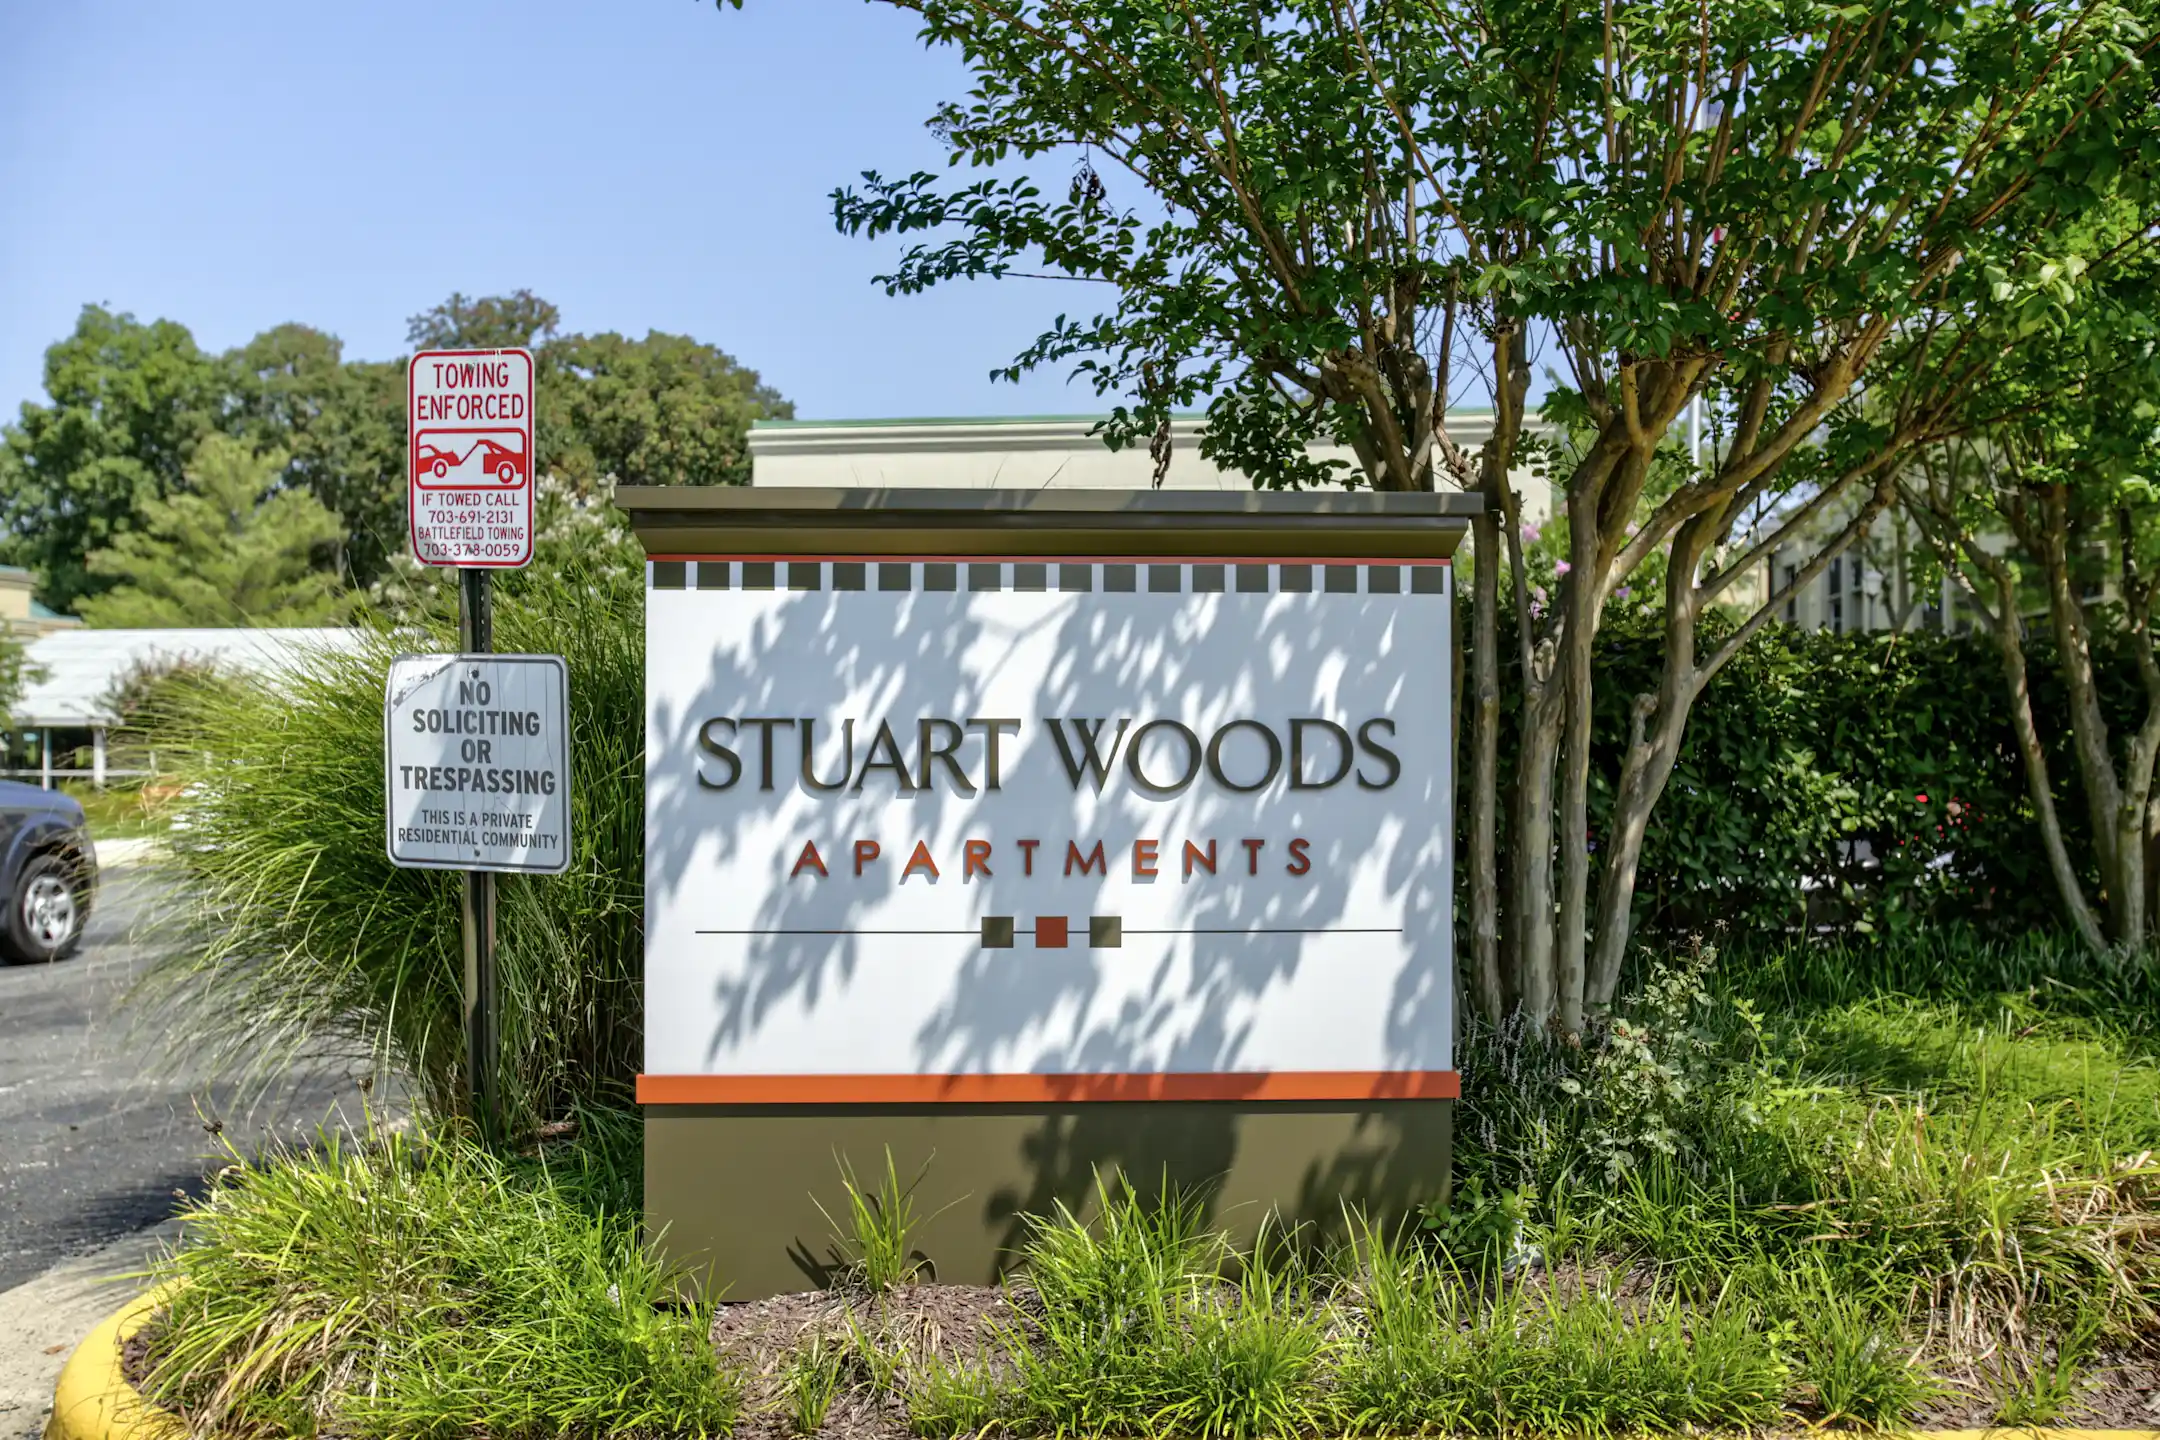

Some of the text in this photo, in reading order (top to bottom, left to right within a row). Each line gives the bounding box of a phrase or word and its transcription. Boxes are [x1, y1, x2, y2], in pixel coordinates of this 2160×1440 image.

[433, 363, 509, 389] TOWING
[418, 394, 524, 420] ENFORCED
[422, 492, 519, 506] IF TOWED CALL
[428, 510, 514, 524] 703-691-2131
[418, 526, 524, 540] BATTLEFIELD TOWING
[424, 543, 520, 557] 703-378-0059
[459, 680, 491, 705] NO
[412, 709, 540, 736] SOLICITING
[461, 739, 492, 764] OR
[697, 716, 1402, 794] STUART WOODS
[400, 766, 555, 795] TRESPASSING
[422, 810, 532, 829] THIS IS A PRIVATE
[398, 828, 558, 849] RESIDENTIAL COMMUNITY
[790, 838, 1312, 876] APARTMENTS
